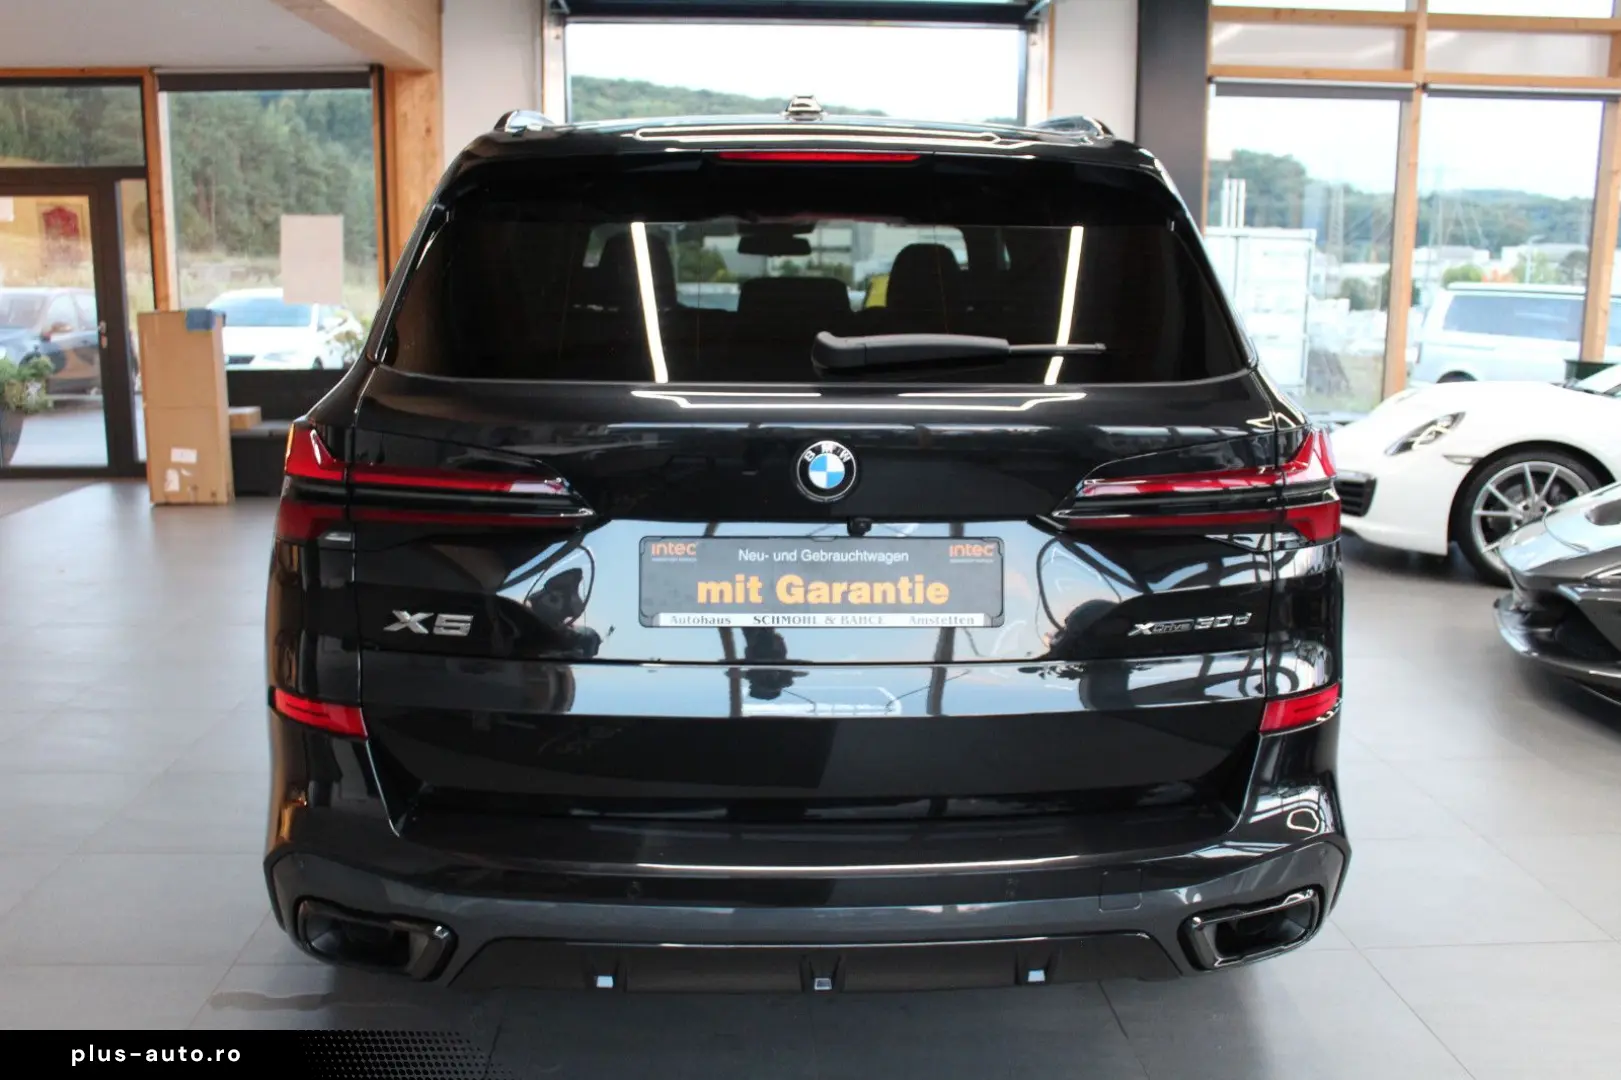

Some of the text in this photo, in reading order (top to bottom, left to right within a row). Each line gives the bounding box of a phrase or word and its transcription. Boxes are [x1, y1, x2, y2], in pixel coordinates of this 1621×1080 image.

[803, 443, 851, 463] BMW
[738, 549, 909, 565] Neu- und Gebrauchtwagen
[697, 573, 949, 605] mit Garantie
[383, 609, 473, 637] X5
[670, 615, 732, 625] Autohaus
[753, 615, 817, 625] SCHMOHL
[824, 615, 837, 625] &
[908, 615, 975, 625] Amstetten
